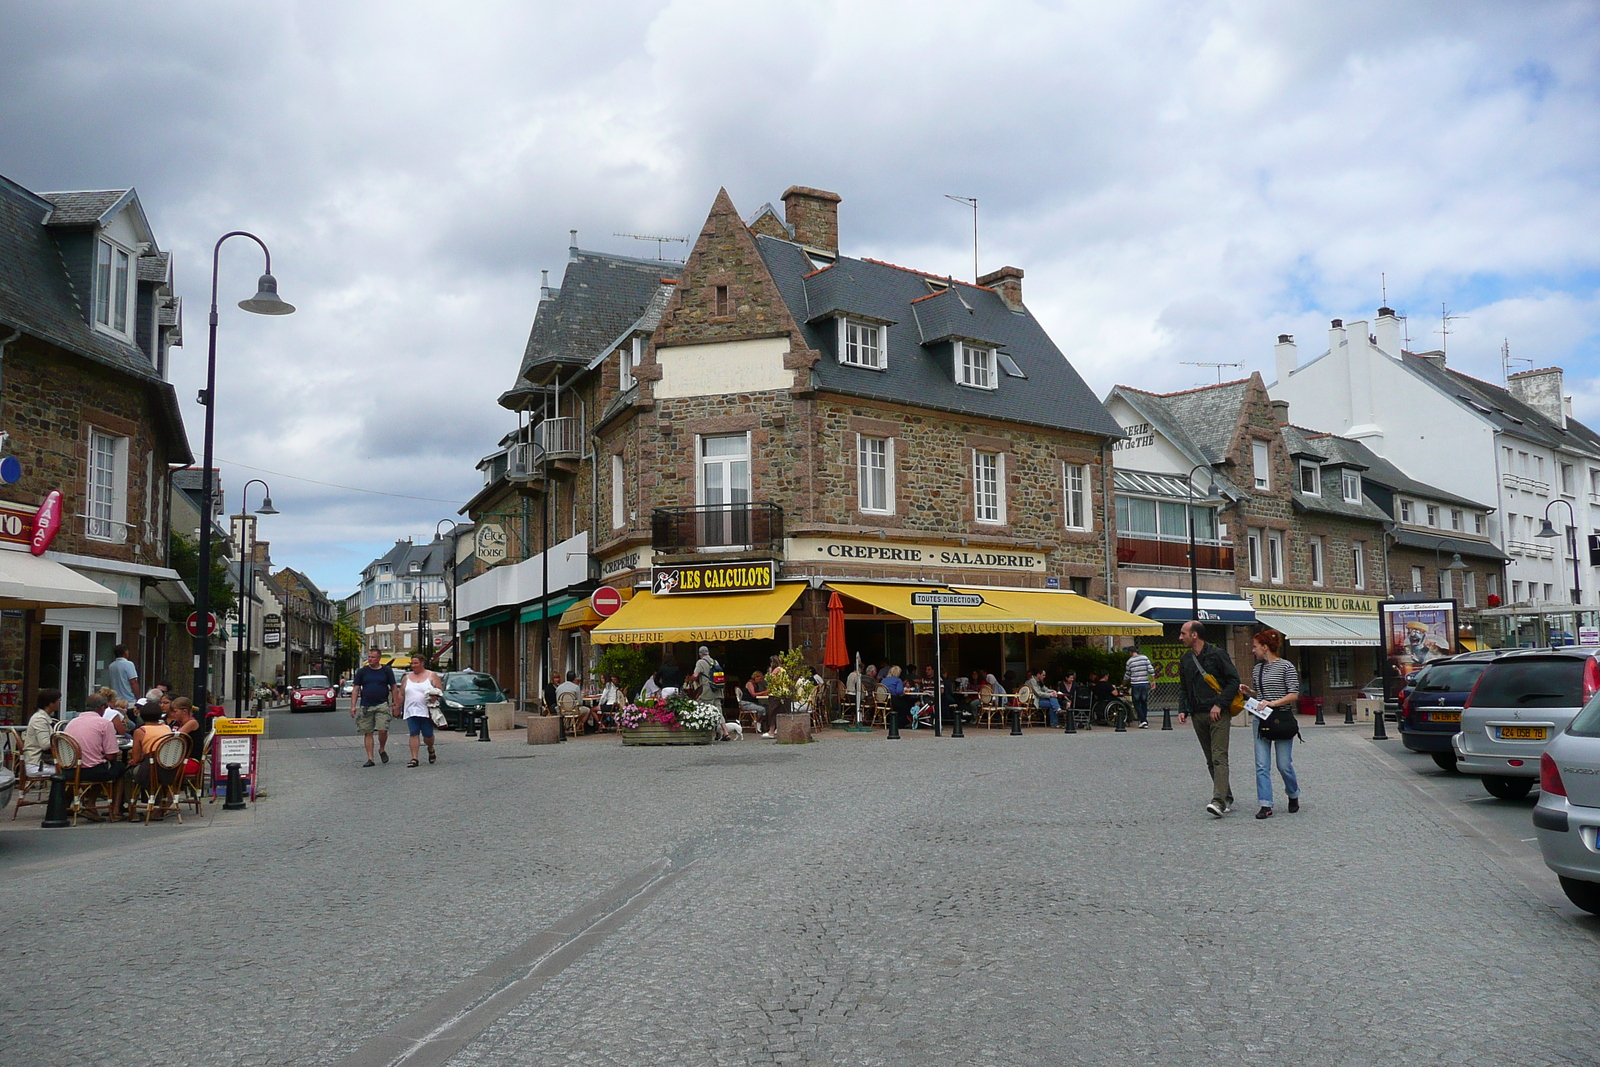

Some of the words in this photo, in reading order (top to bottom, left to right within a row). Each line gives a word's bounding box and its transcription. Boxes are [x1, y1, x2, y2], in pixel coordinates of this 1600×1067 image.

[1125, 439, 1135, 450] de
[1135, 433, 1155, 448] THÉ
[33, 499, 56, 547] TABAC
[478, 547, 503, 557] house
[826, 544, 922, 562] CREPERIE
[940, 551, 1035, 567] SALADERIE
[604, 552, 638, 574] CREPERIE
[680, 570, 701, 589] LES
[704, 567, 770, 588] CALCULOTS
[918, 595, 941, 603] TOUTES
[943, 595, 979, 604] DIRECTIONS
[1259, 593, 1323, 609] BISCUITERIE
[1325, 597, 1340, 610] DU
[1342, 599, 1372, 612] GRAAL
[940, 623, 955, 632] LES
[960, 623, 1015, 633] CALCULOTS
[1061, 626, 1101, 635] GRILLADES
[1122, 627, 1142, 635] PATES
[608, 633, 664, 643] CREPERIE
[690, 629, 754, 641] SALADERIE
[1501, 728, 1514, 737] 424
[1533, 728, 1542, 737] 78
